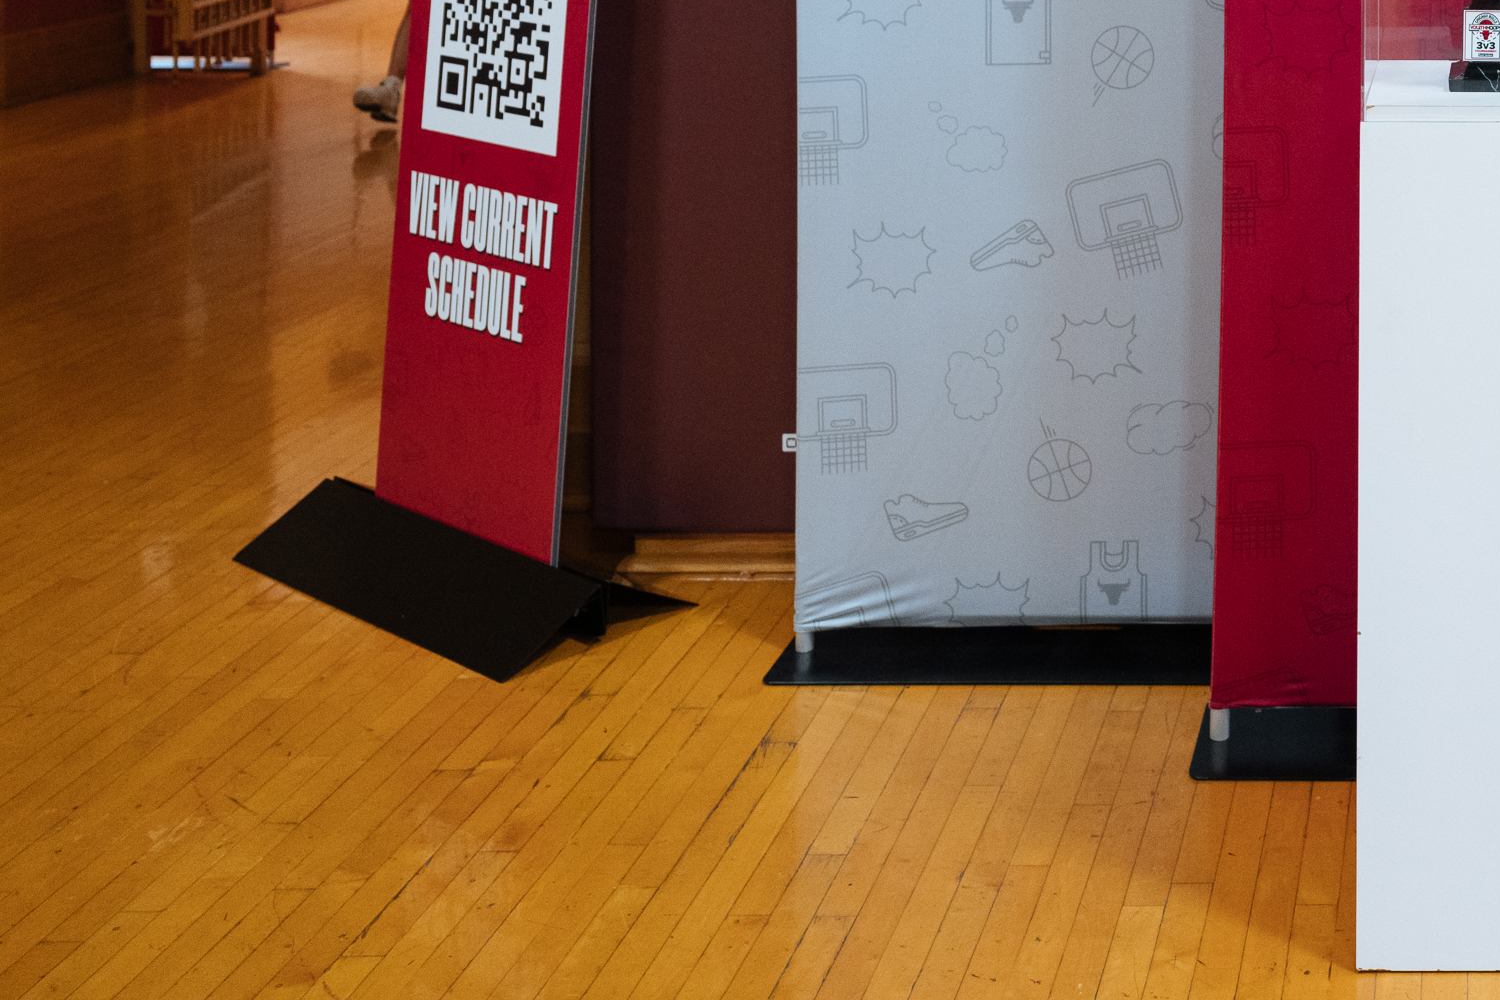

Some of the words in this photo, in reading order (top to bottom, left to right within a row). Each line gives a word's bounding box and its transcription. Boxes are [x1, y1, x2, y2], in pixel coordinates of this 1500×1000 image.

[1476, 41, 1495, 49] 3v3
[409, 170, 460, 244] VIEW
[460, 183, 559, 270] CURRENT
[424, 252, 527, 344] SCHEDULE
